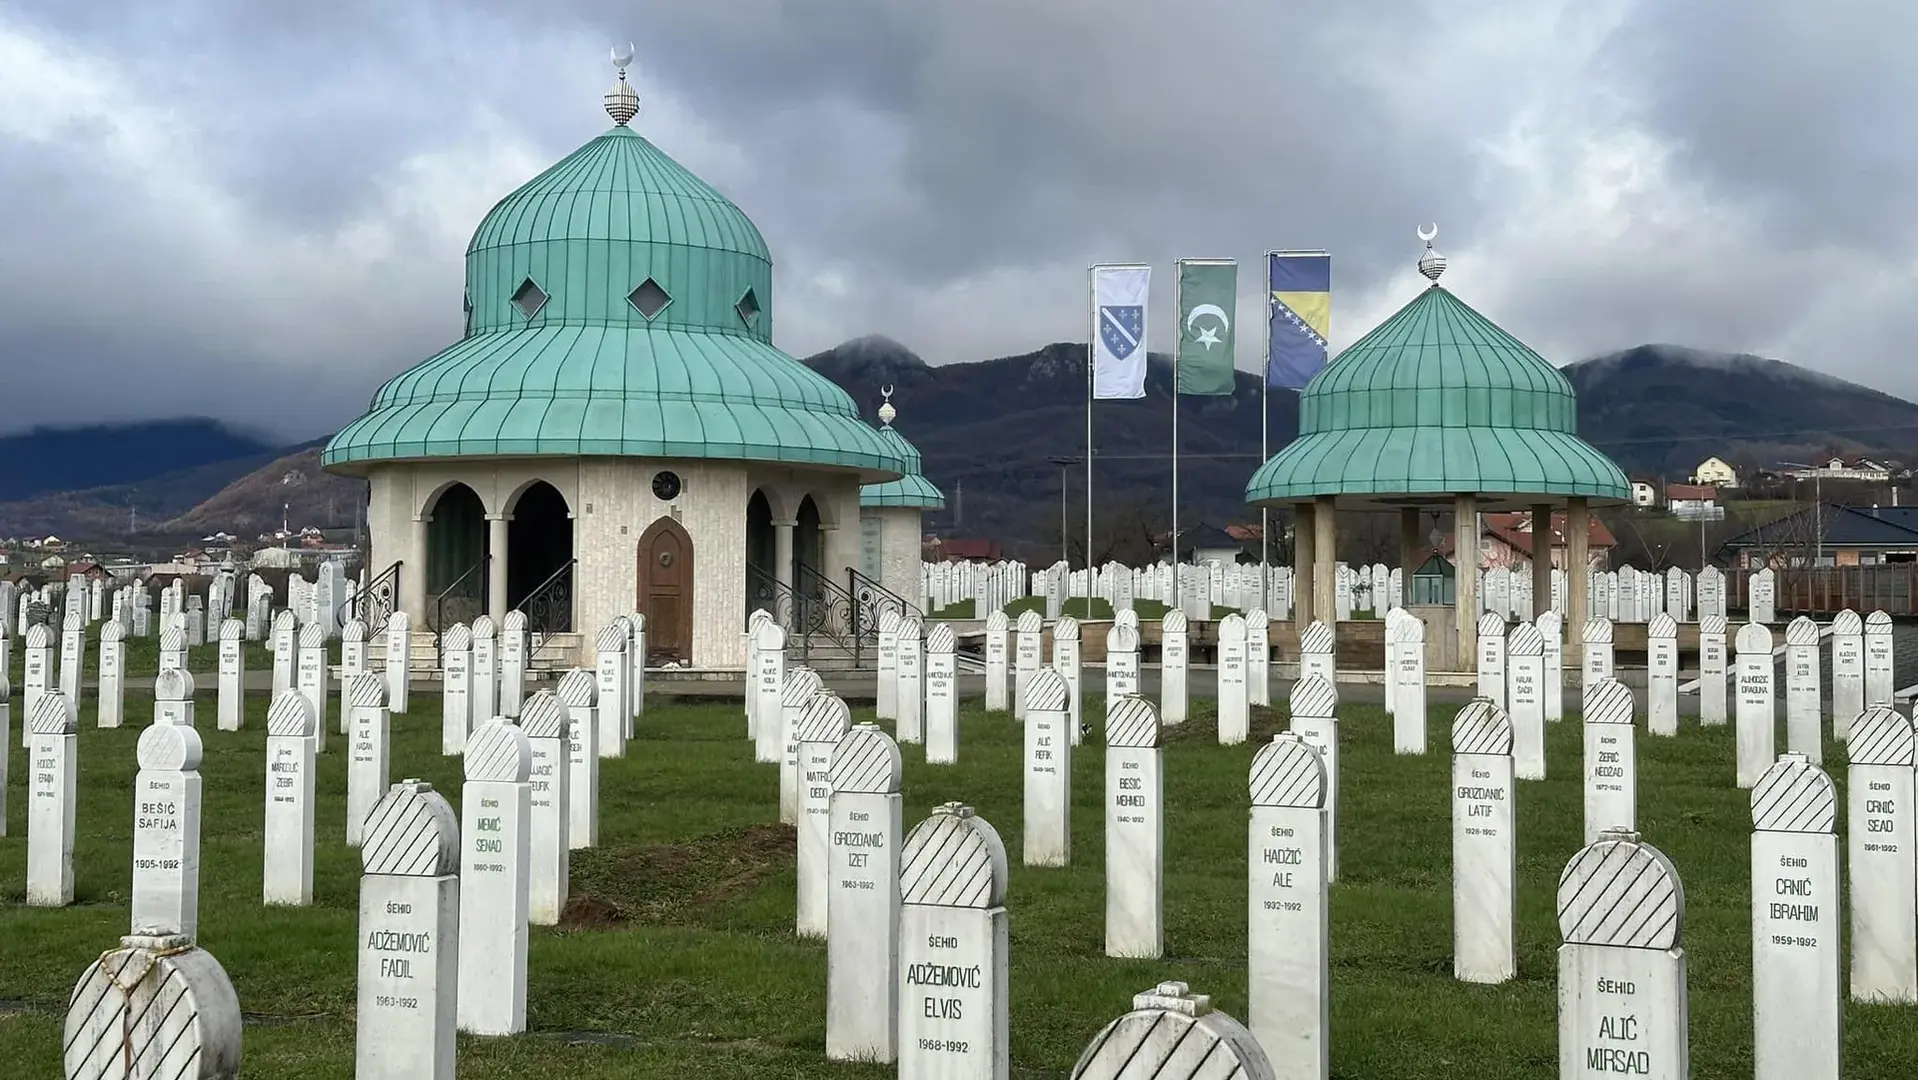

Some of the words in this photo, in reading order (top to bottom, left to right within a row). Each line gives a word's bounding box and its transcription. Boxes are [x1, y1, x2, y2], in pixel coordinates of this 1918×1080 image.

[1594, 766, 1624, 778] NEDŽAD
[150, 781, 170, 790] ŠEHID
[1120, 777, 1142, 790] BEŠIĆ
[1868, 780, 1891, 791] ŠEHID
[1116, 794, 1146, 807] MEHMED
[1457, 786, 1505, 801] GROZDANIĆ
[142, 802, 176, 814] BEŠIĆ
[1468, 804, 1493, 817] LATIF
[1866, 800, 1895, 814] CRNIĆ
[849, 811, 870, 822] ŠEHID
[138, 818, 177, 830] SAFIJA
[478, 816, 501, 832] MEMIĆ
[1868, 819, 1894, 832] SEAD
[1271, 826, 1294, 838] ŠEHID
[476, 838, 502, 853] SENAD
[834, 831, 884, 848] GROZDANIĆ
[848, 853, 869, 868] IZET
[1264, 848, 1302, 864] HADŽIĆ
[1780, 854, 1808, 868] ŠEHID
[136, 860, 179, 869] 1905-1992
[1272, 872, 1292, 888] ALE
[1776, 877, 1812, 896] CRNIĆ
[386, 900, 412, 914] ŠEHID
[1264, 900, 1302, 912] 1932-1992
[1770, 902, 1818, 922] IBRAHIM
[367, 930, 430, 953] ADŽEMOVIĆ
[928, 934, 958, 949] ŠEHID
[1772, 935, 1817, 948] 1959-1992
[380, 958, 414, 979] FADIL
[906, 962, 981, 989] ADŽEMOVIĆ
[1597, 976, 1636, 994] ŠEHID
[376, 996, 418, 1008] 1963-1992
[924, 996, 962, 1020] ELVIS
[1598, 1014, 1638, 1040] ALIĆ
[918, 1038, 968, 1053] 1968-1992
[1587, 1047, 1650, 1075] MIRSAD
